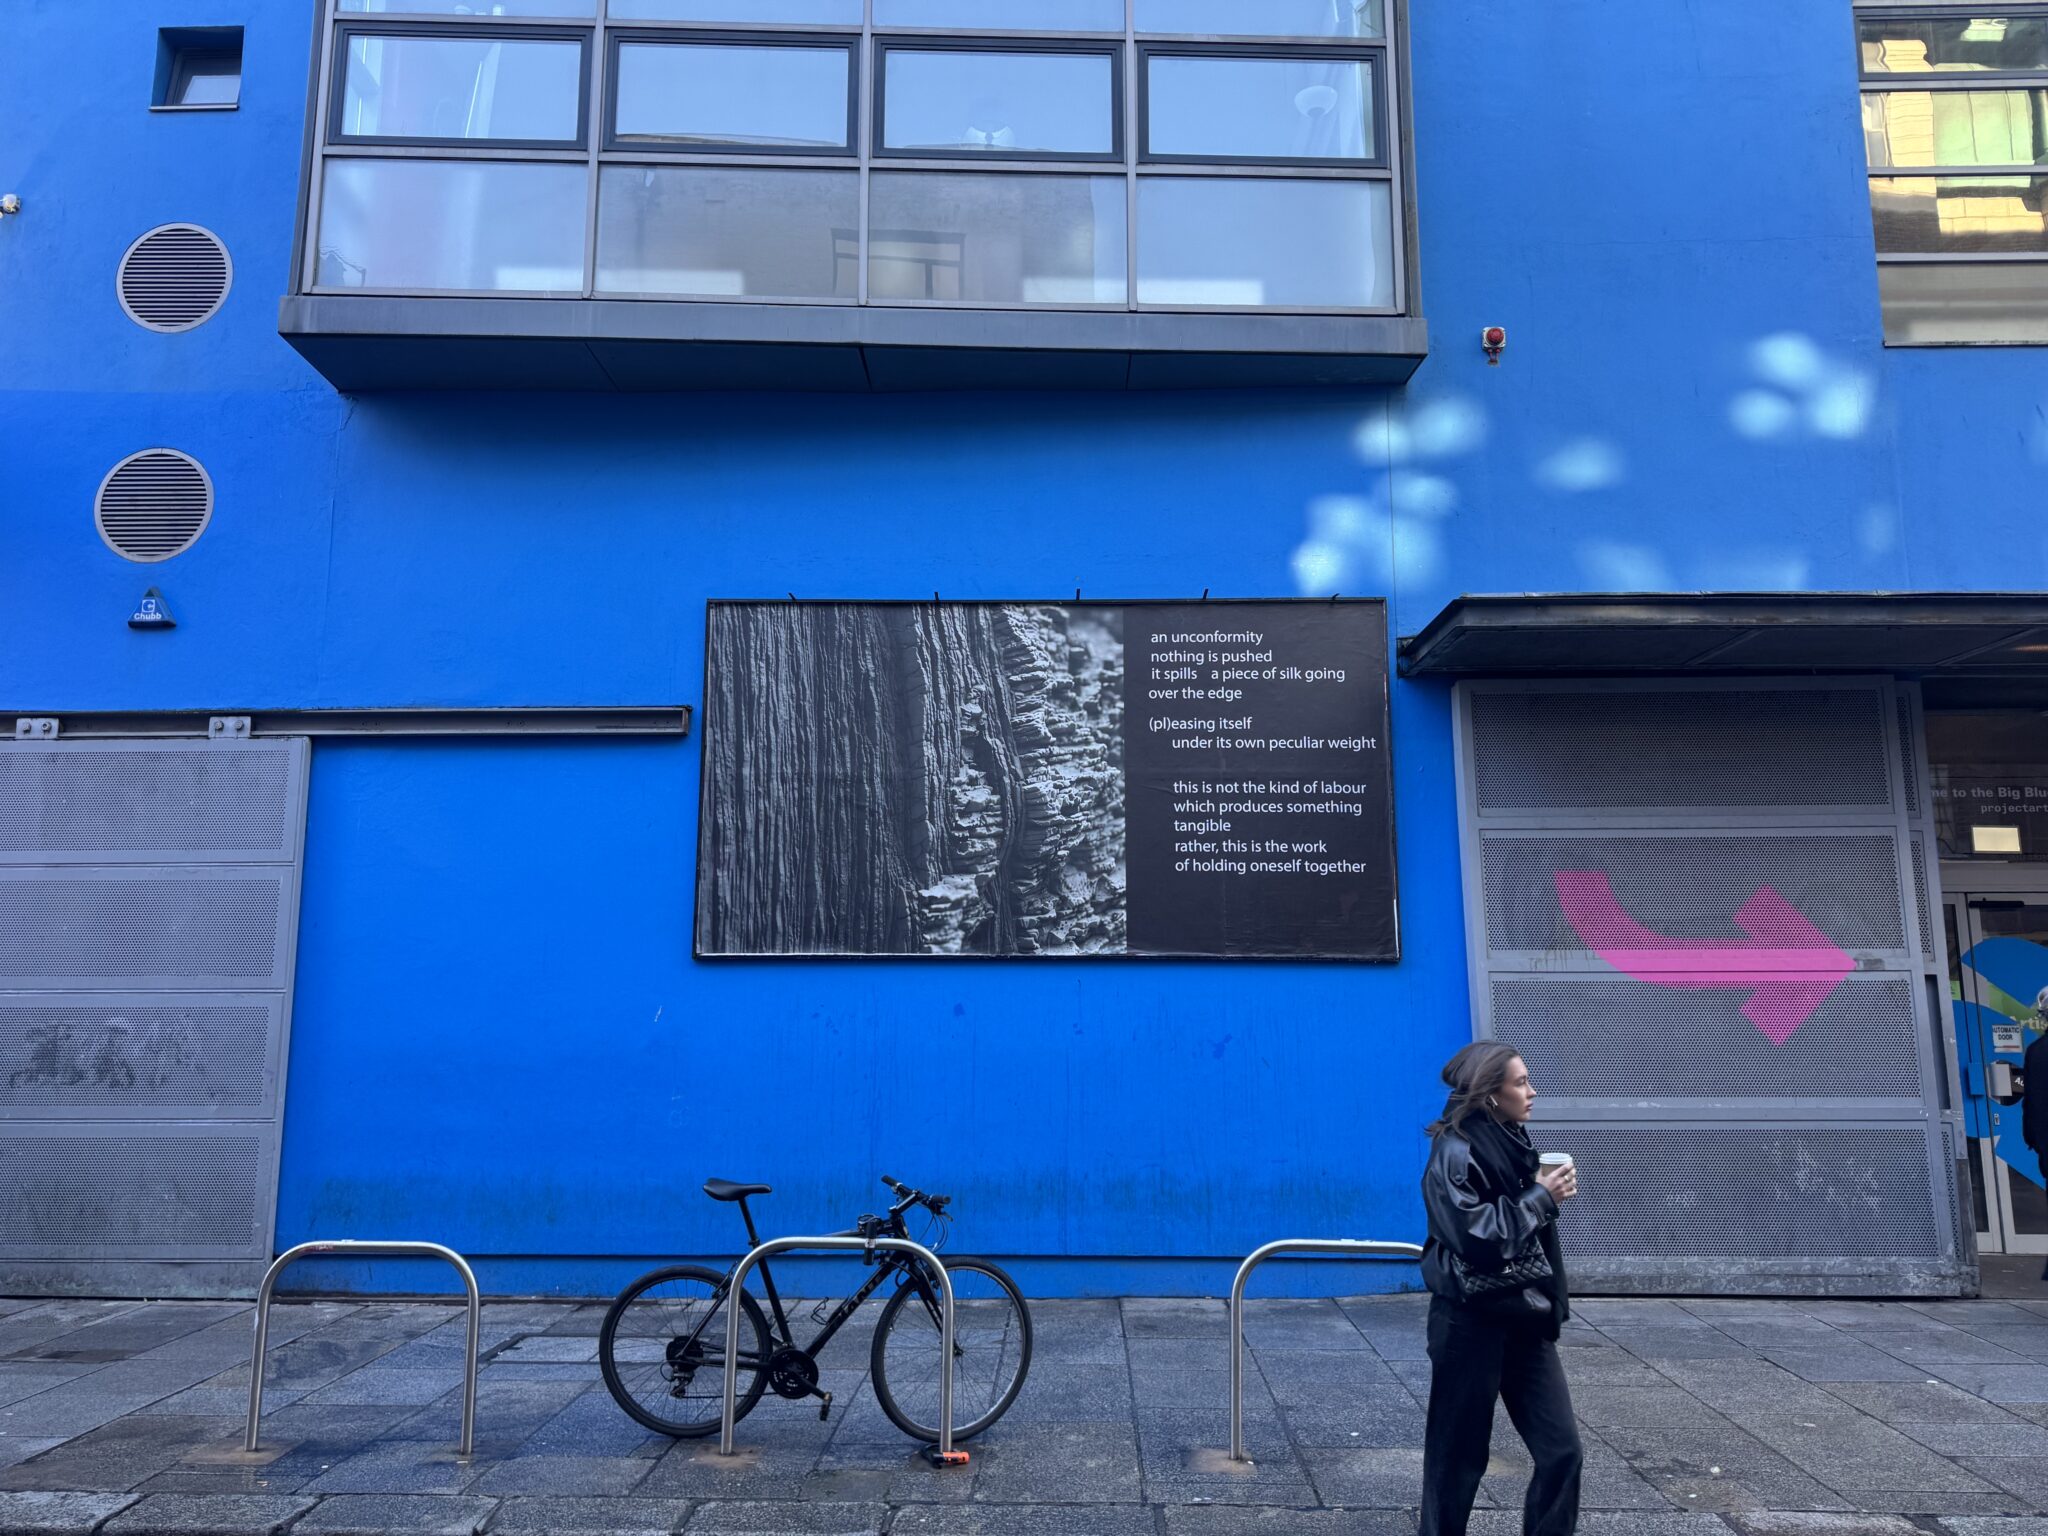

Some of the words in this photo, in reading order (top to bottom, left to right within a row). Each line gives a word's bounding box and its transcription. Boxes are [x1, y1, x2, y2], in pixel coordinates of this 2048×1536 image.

[133, 612, 162, 621] Chubb
[1150, 633, 1168, 644] an
[1171, 629, 1264, 646] unconformity
[1150, 649, 1205, 666] nothing
[1208, 649, 1219, 663] is
[1221, 649, 1273, 666] pushed
[1151, 667, 1161, 680] it
[1163, 666, 1198, 683] spills
[1210, 669, 1219, 680] a
[1222, 667, 1260, 683] piece
[1261, 666, 1278, 680] of
[1279, 666, 1303, 680] silk
[1304, 666, 1346, 683] going
[1148, 689, 1179, 700] over
[1181, 685, 1205, 700] the
[1207, 685, 1243, 703] edge
[1149, 716, 1216, 733] (pl)easing
[1219, 716, 1253, 730] itself
[1172, 735, 1214, 749] under
[1216, 736, 1232, 749] its
[1234, 738, 1266, 749] own
[1269, 735, 1325, 752] peculiar
[1327, 735, 1377, 752] weight
[1173, 779, 1199, 794] this
[1201, 780, 1213, 794] is
[1215, 781, 1240, 794] not
[1242, 780, 1266, 794] the
[1269, 780, 1300, 794] kind
[1303, 780, 1319, 794] of
[1320, 780, 1367, 794] labour
[1952, 787, 1967, 798] to
[1971, 787, 1994, 798] the
[1998, 787, 2020, 800] Big
[2024, 787, 2048, 798] Blu
[1173, 799, 1215, 813] which
[1219, 799, 1284, 816] produces
[1286, 799, 1362, 817] something
[1173, 818, 1232, 835] tangible
[1175, 838, 1221, 855] rather,
[1222, 838, 1248, 853] this
[1251, 839, 1262, 853] is
[1264, 839, 1289, 853] the
[1291, 839, 1328, 853] work
[1174, 857, 1190, 872] of
[1192, 858, 1247, 875] holding
[1249, 858, 1302, 873] oneself
[1304, 859, 1367, 876] together
[1993, 1026, 2020, 1034] AUTOMATIC
